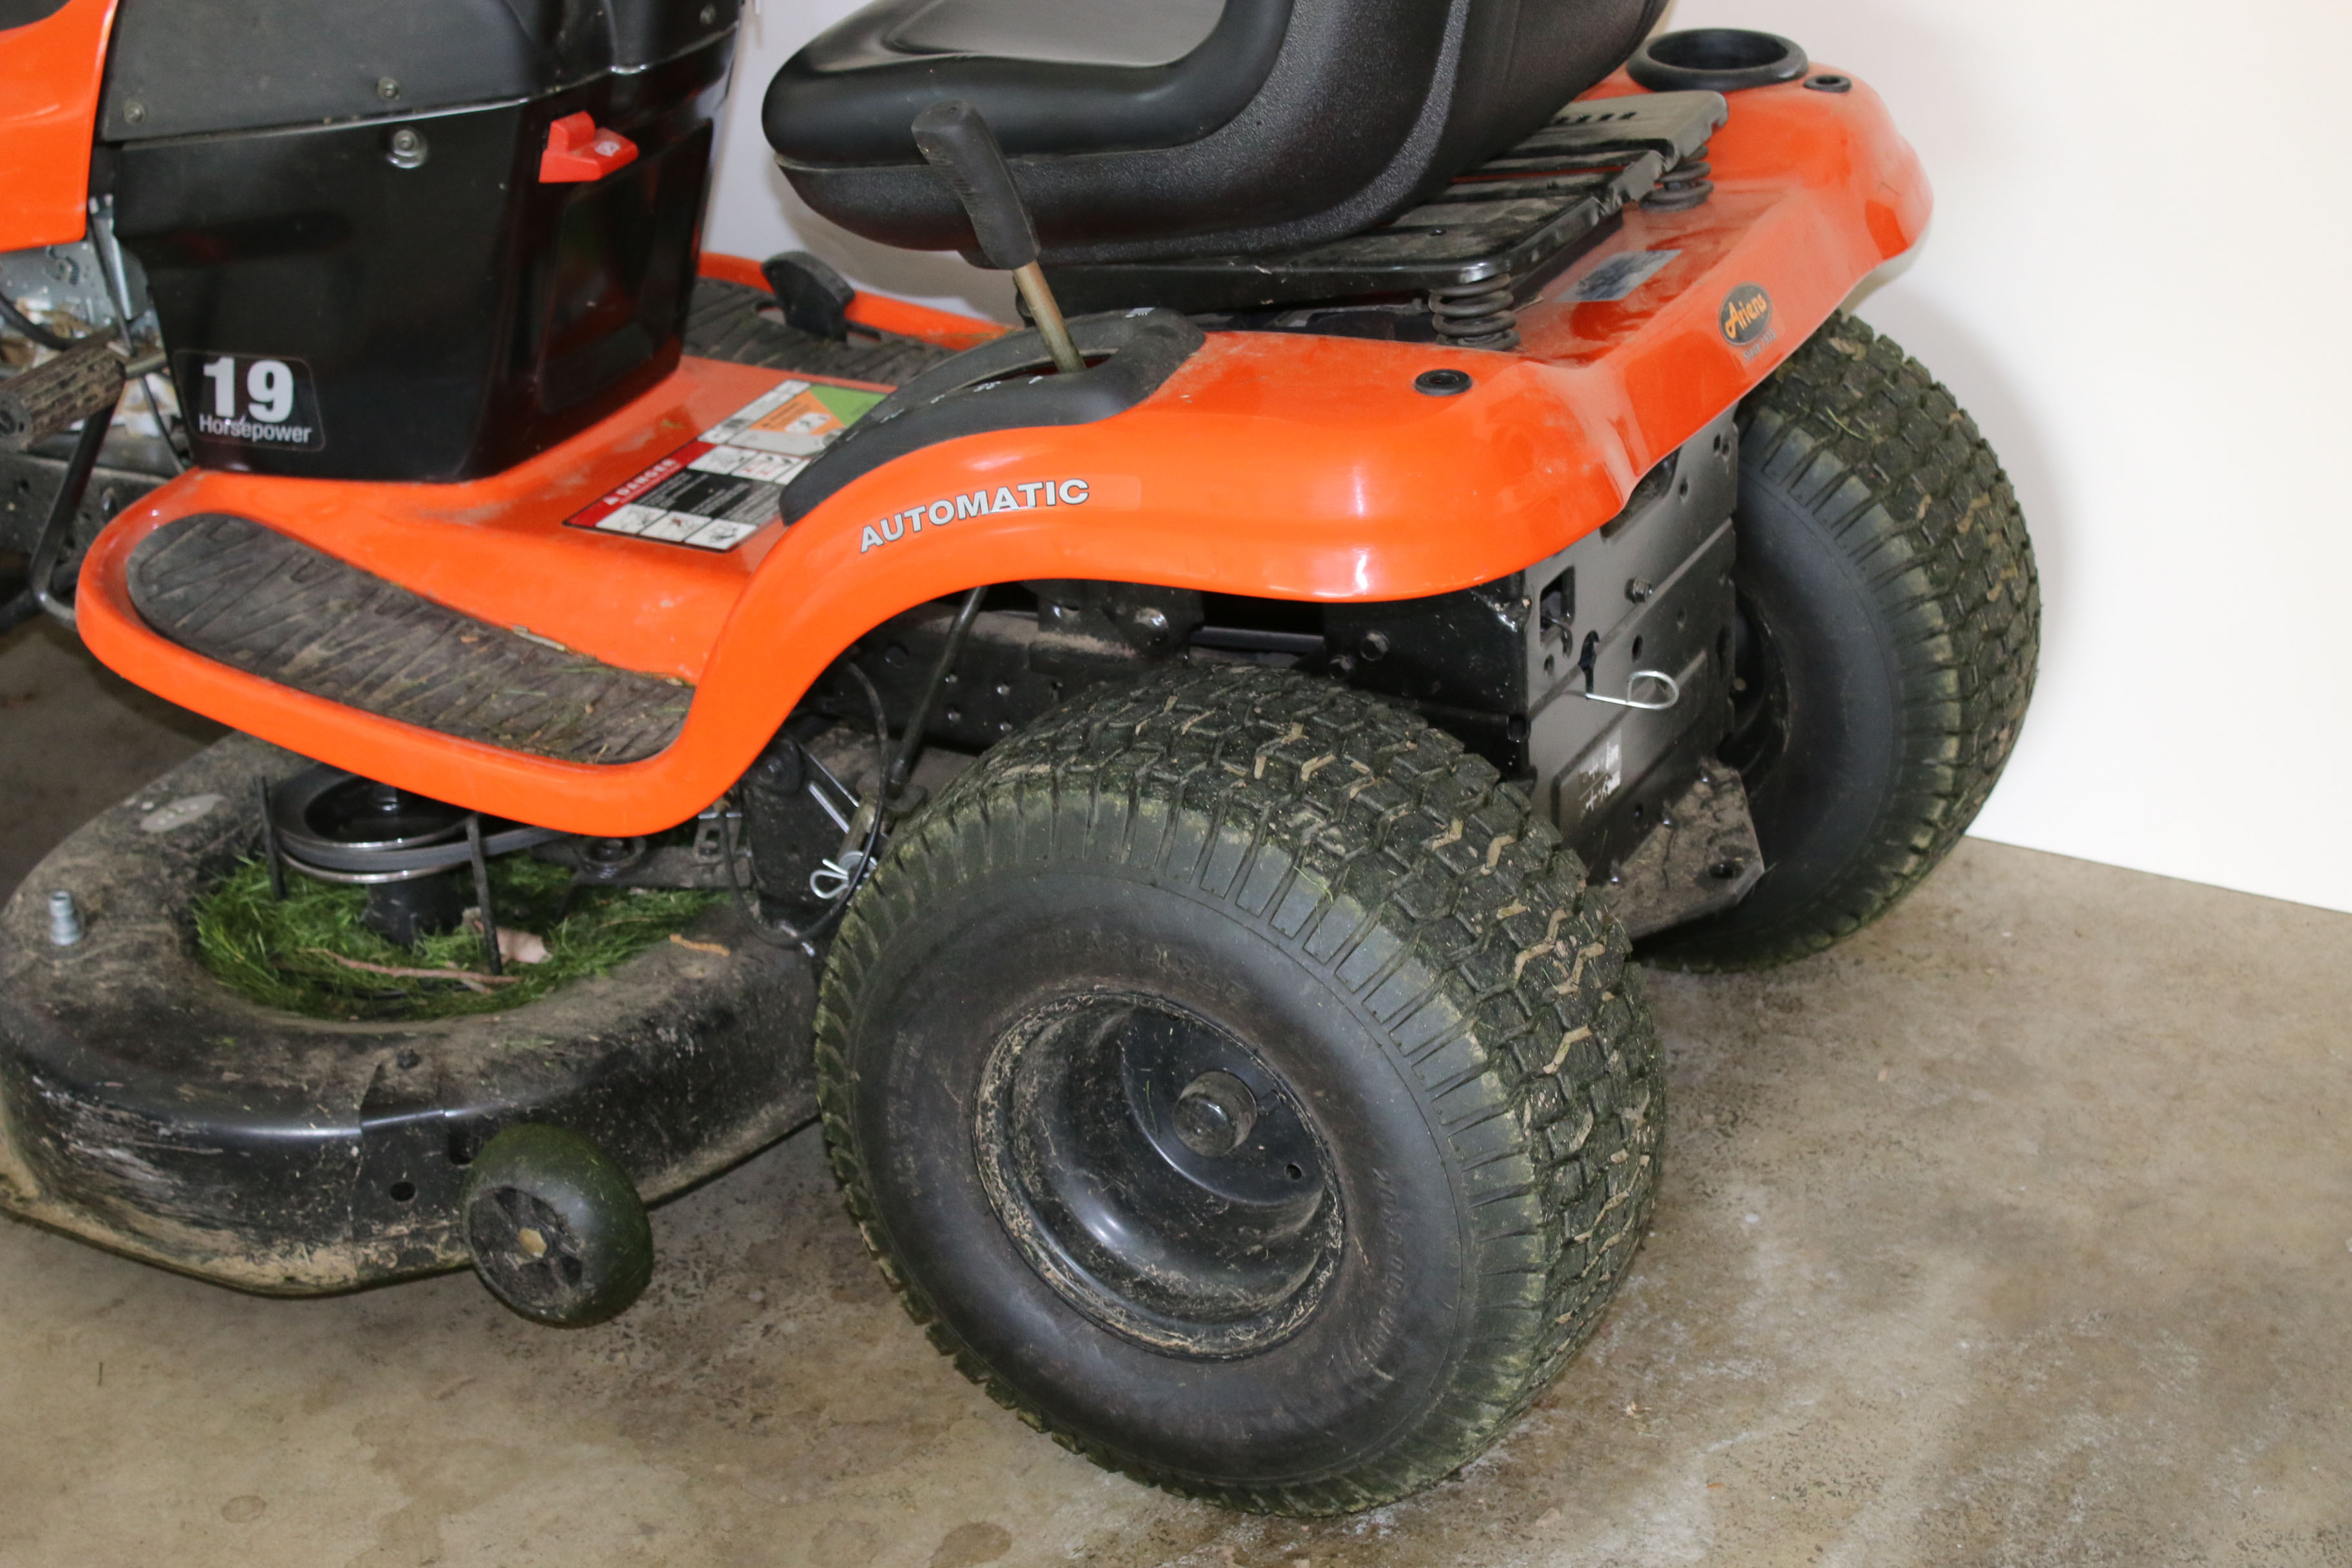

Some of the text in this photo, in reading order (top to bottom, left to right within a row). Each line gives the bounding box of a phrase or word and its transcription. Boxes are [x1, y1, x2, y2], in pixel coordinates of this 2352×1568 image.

[1725, 294, 1767, 339] Ariens
[203, 356, 294, 423] 19
[199, 413, 312, 443] Horsepower
[859, 478, 1090, 553] AUTOMATIC
